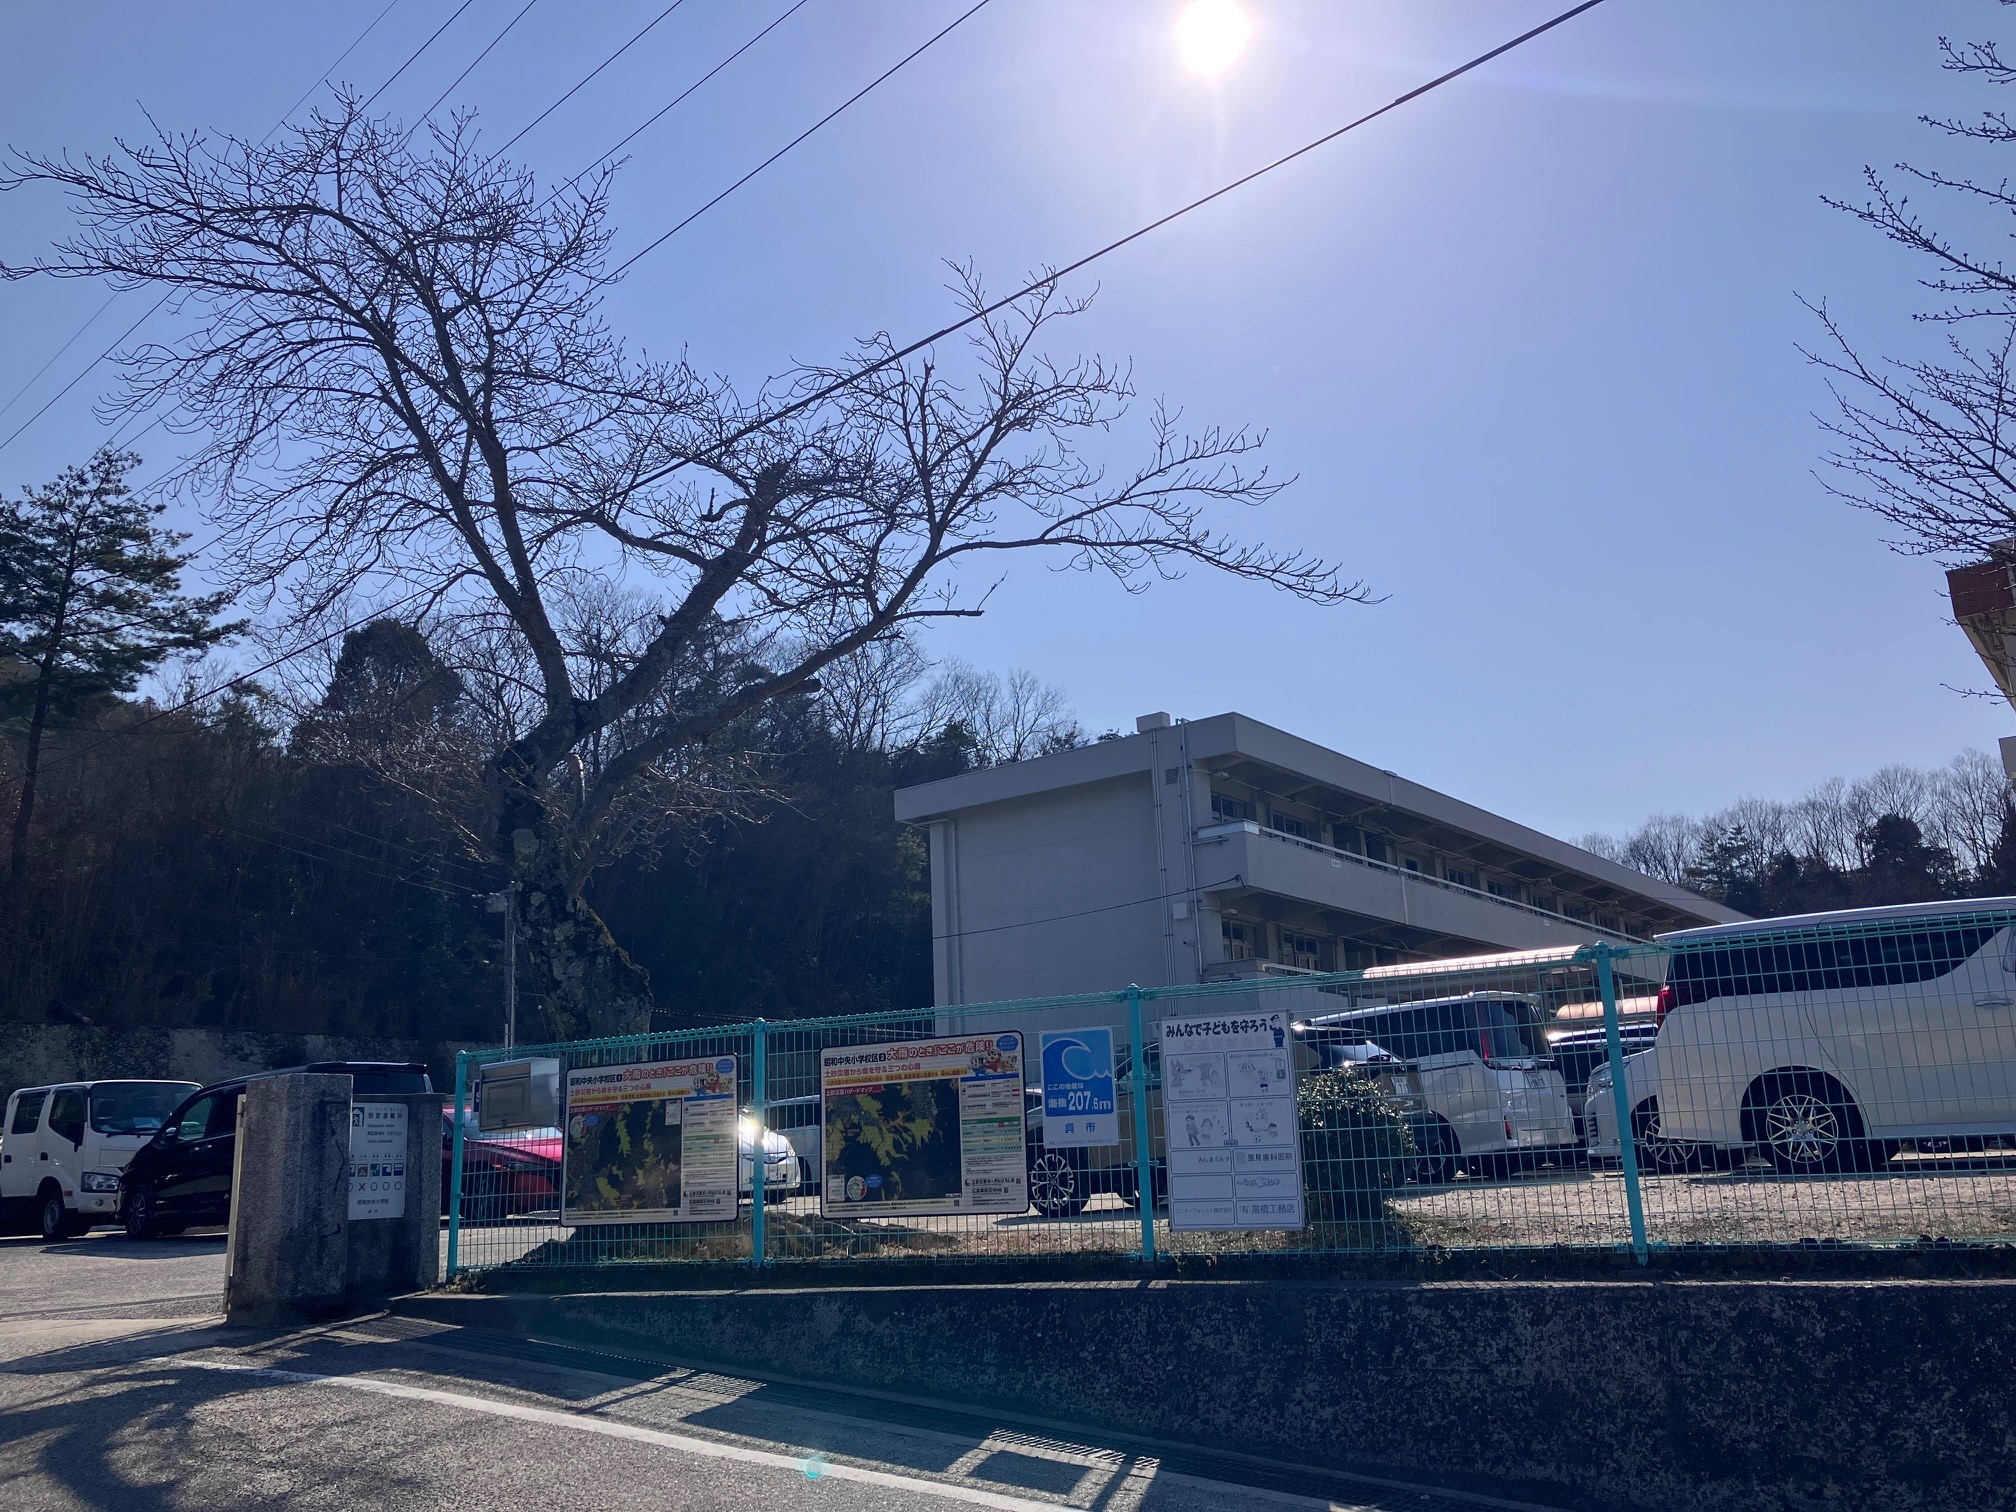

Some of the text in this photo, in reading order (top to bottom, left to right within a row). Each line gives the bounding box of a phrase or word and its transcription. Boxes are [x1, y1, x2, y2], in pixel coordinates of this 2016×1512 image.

[1165, 1018, 1268, 1038] みんなで子どもを守ろう
[825, 1063, 921, 1078] 土砂災害から命を守る三つの心得
[1198, 1156, 1231, 1164] みしまミルク
